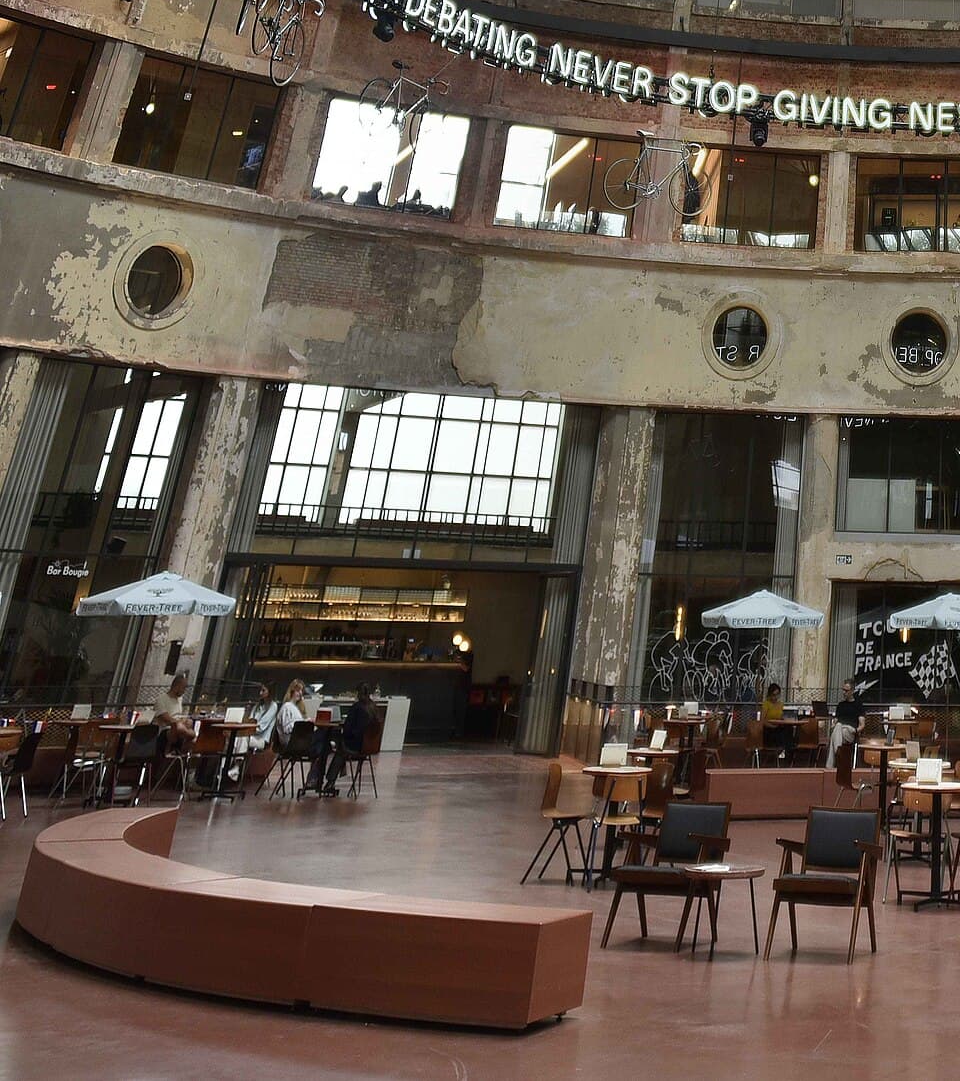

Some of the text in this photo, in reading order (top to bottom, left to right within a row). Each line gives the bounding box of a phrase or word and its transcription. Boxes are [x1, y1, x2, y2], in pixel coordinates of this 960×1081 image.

[549, 42, 651, 98] NEVER
[668, 72, 758, 113] STOP
[773, 90, 892, 129] GIVING
[47, 563, 89, 578] Bar Bougie
[855, 641, 875, 655] DE
[854, 652, 913, 675] FRANCE
